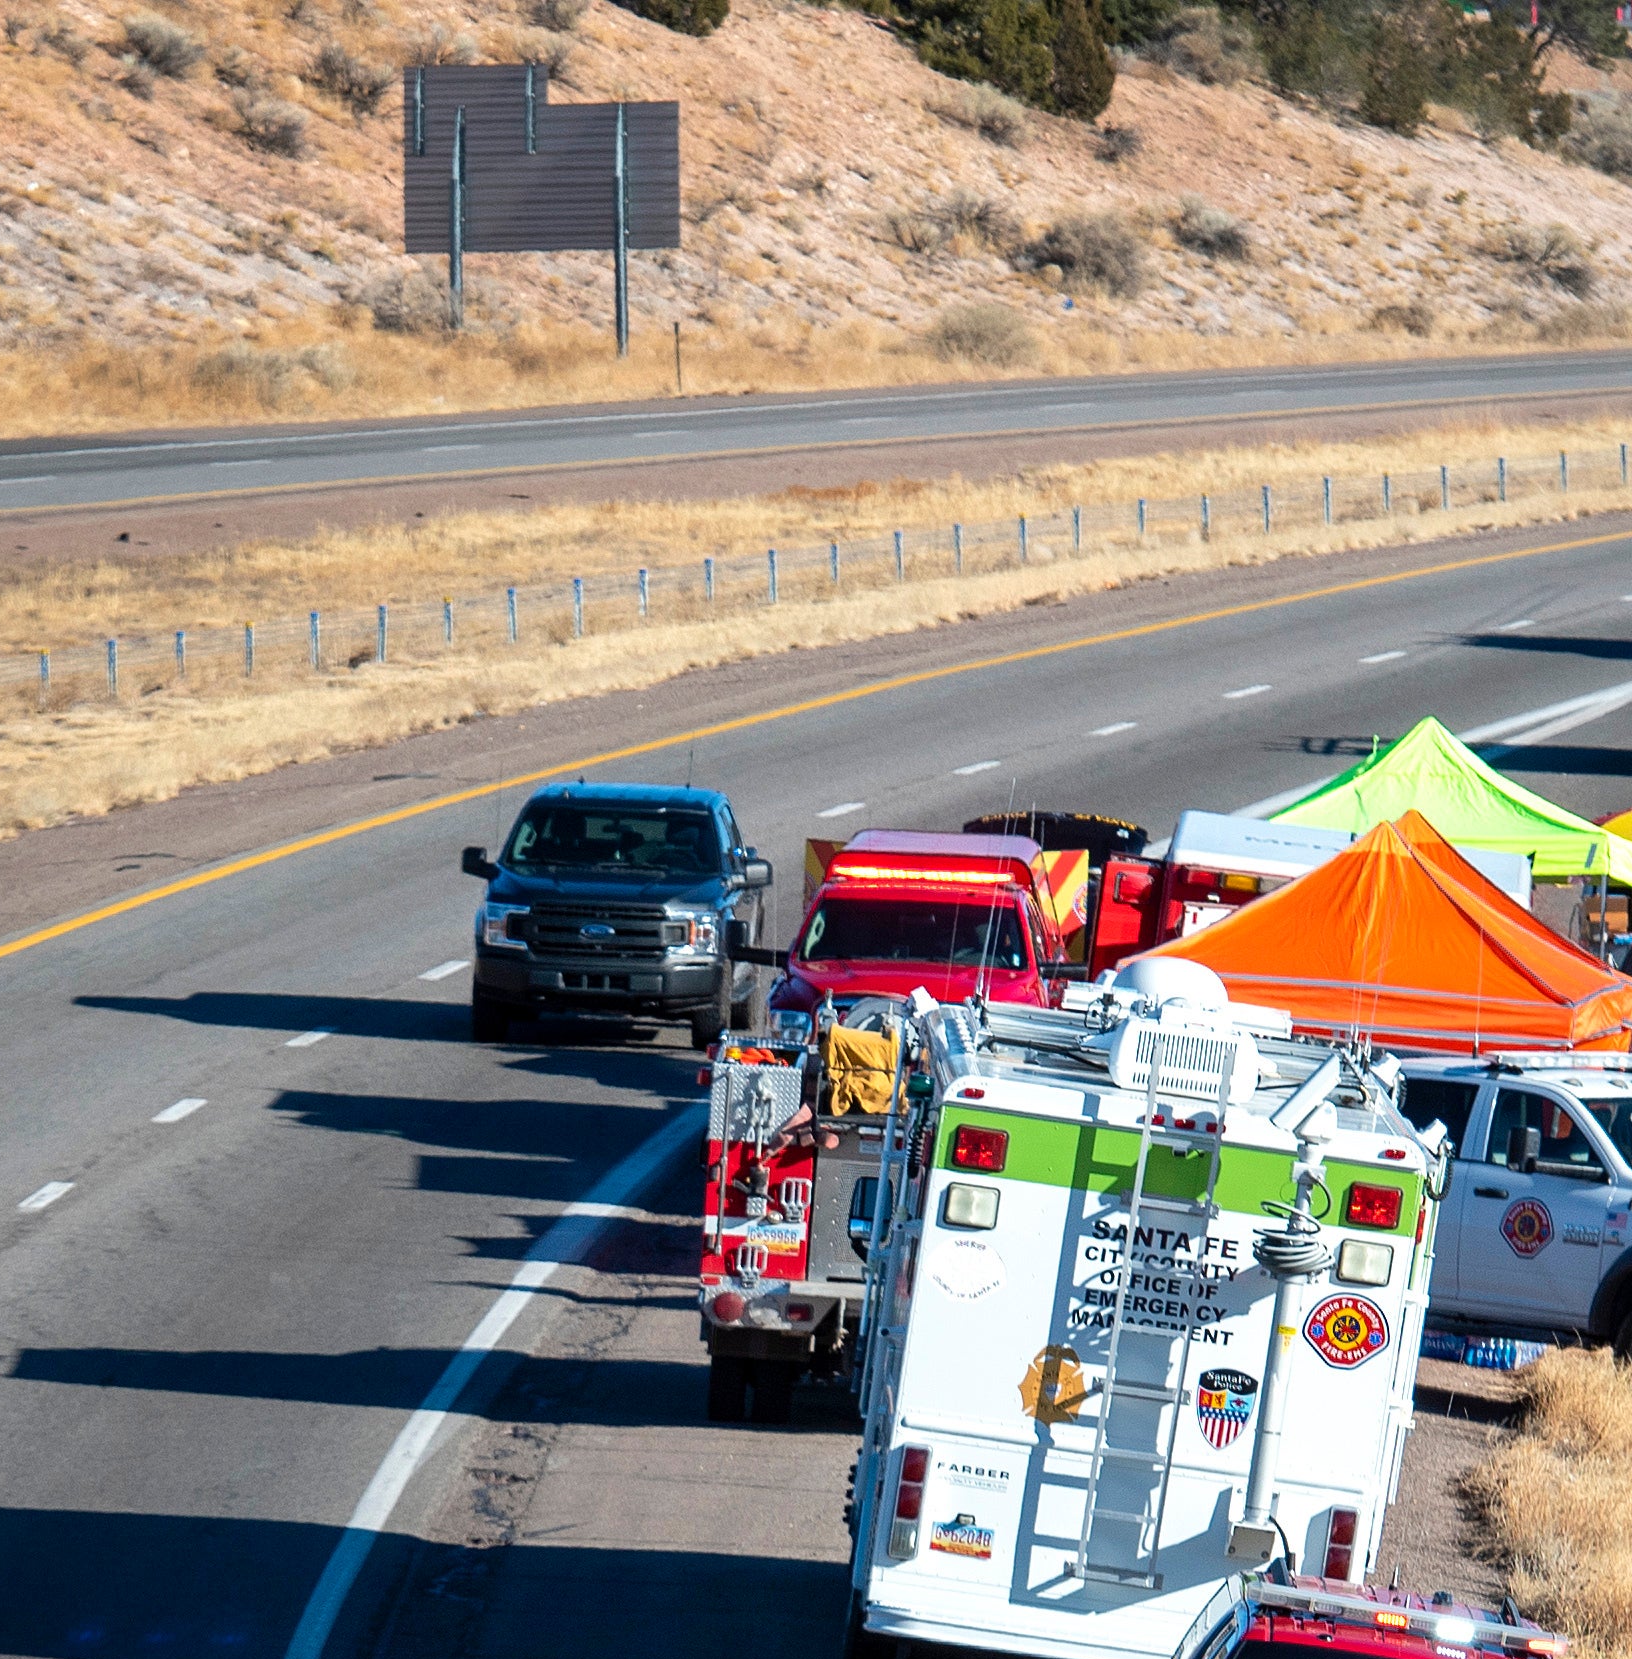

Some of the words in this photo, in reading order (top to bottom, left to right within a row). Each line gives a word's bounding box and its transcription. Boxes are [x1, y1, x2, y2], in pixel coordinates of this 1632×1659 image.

[1091, 1220, 1192, 1253] SANTA
[1205, 1237, 1239, 1260] FE
[1188, 1284, 1218, 1300] OF
[1084, 1288, 1228, 1323] EMERGENCY
[937, 1462, 1010, 1480] FARBER
